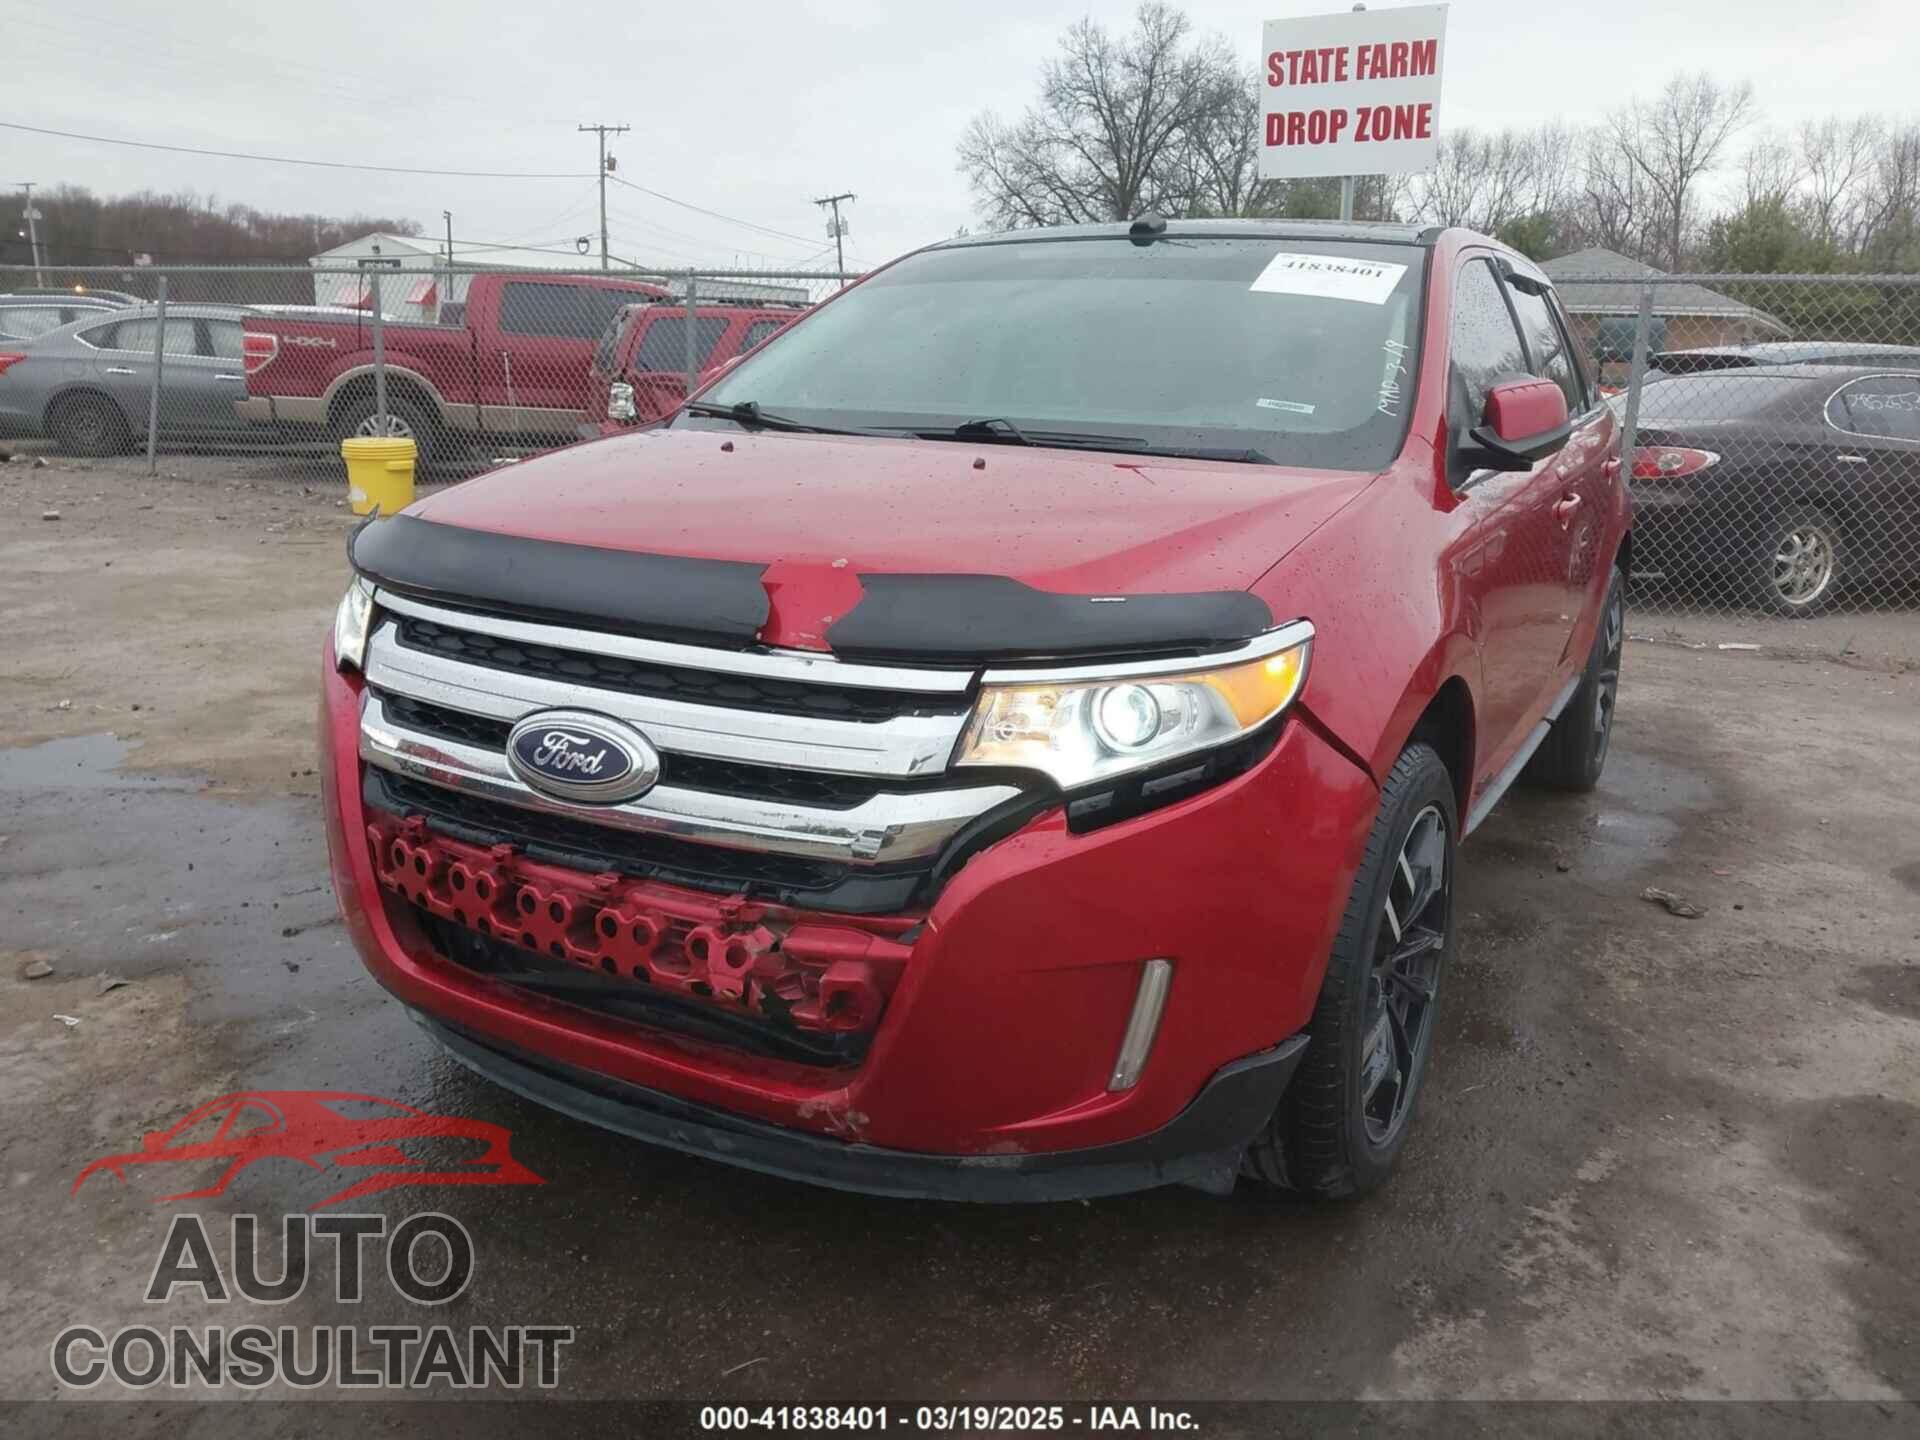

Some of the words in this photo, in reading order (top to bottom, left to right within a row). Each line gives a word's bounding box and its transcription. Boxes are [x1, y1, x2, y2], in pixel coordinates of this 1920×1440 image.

[1267, 46, 1349, 87] STATE
[1356, 39, 1438, 80] FARM
[1266, 109, 1348, 147] DROP
[1354, 103, 1432, 142] ZONE
[533, 731, 606, 774] Ford
